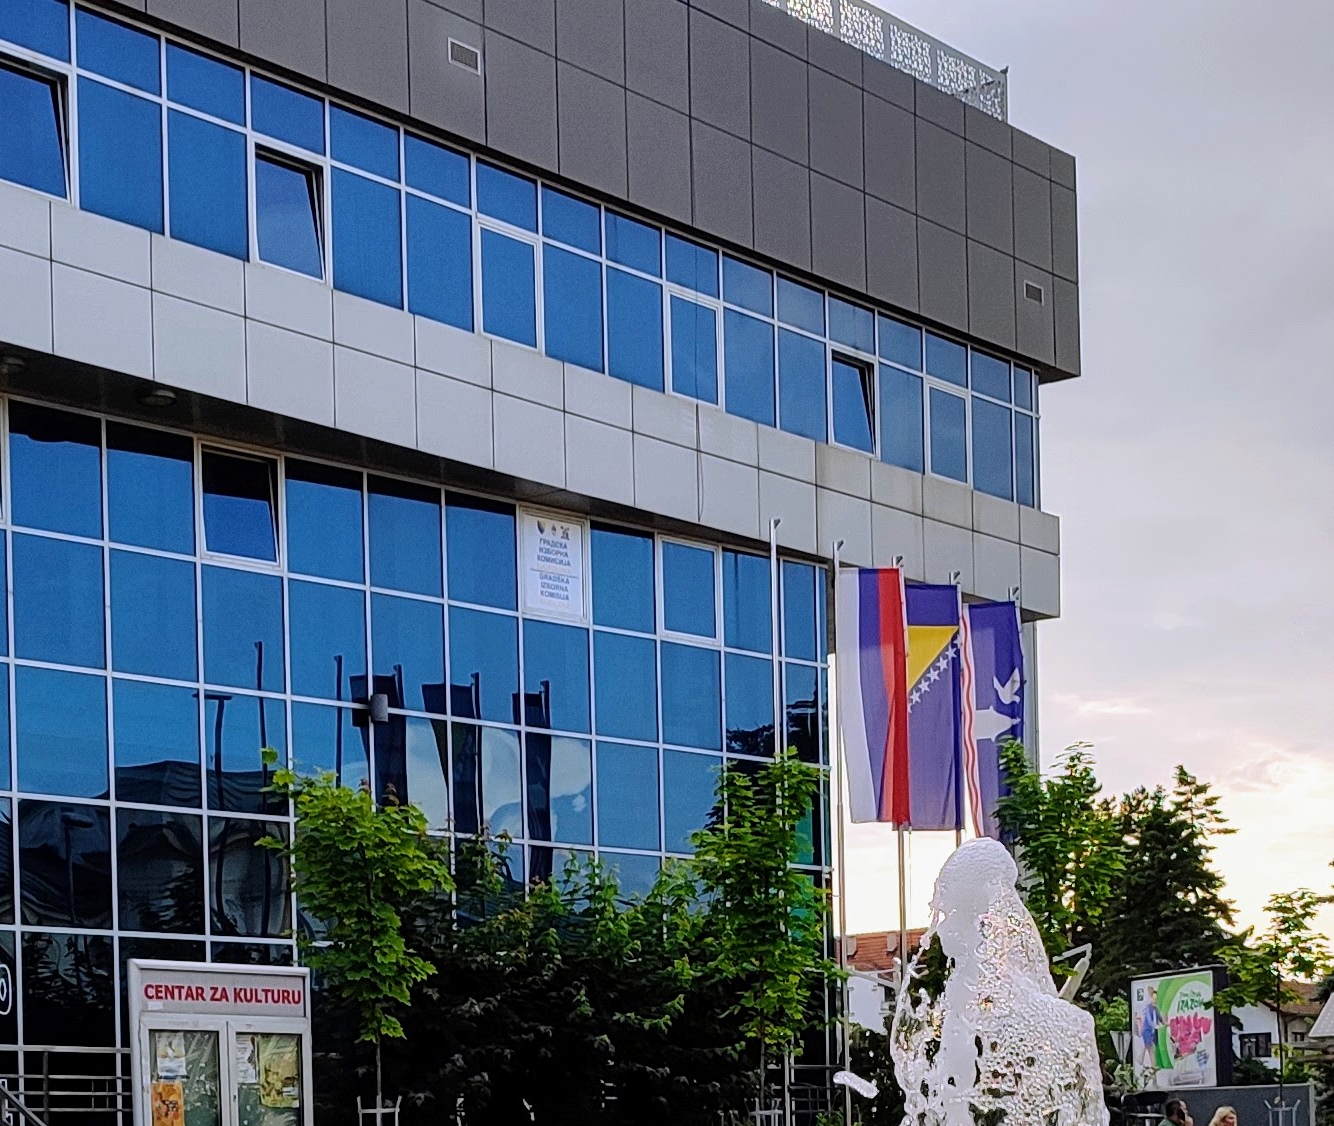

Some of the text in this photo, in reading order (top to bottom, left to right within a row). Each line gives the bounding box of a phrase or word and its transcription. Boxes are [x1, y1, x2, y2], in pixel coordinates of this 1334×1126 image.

[143, 983, 302, 1005] CENTAR ZA KULTURU
